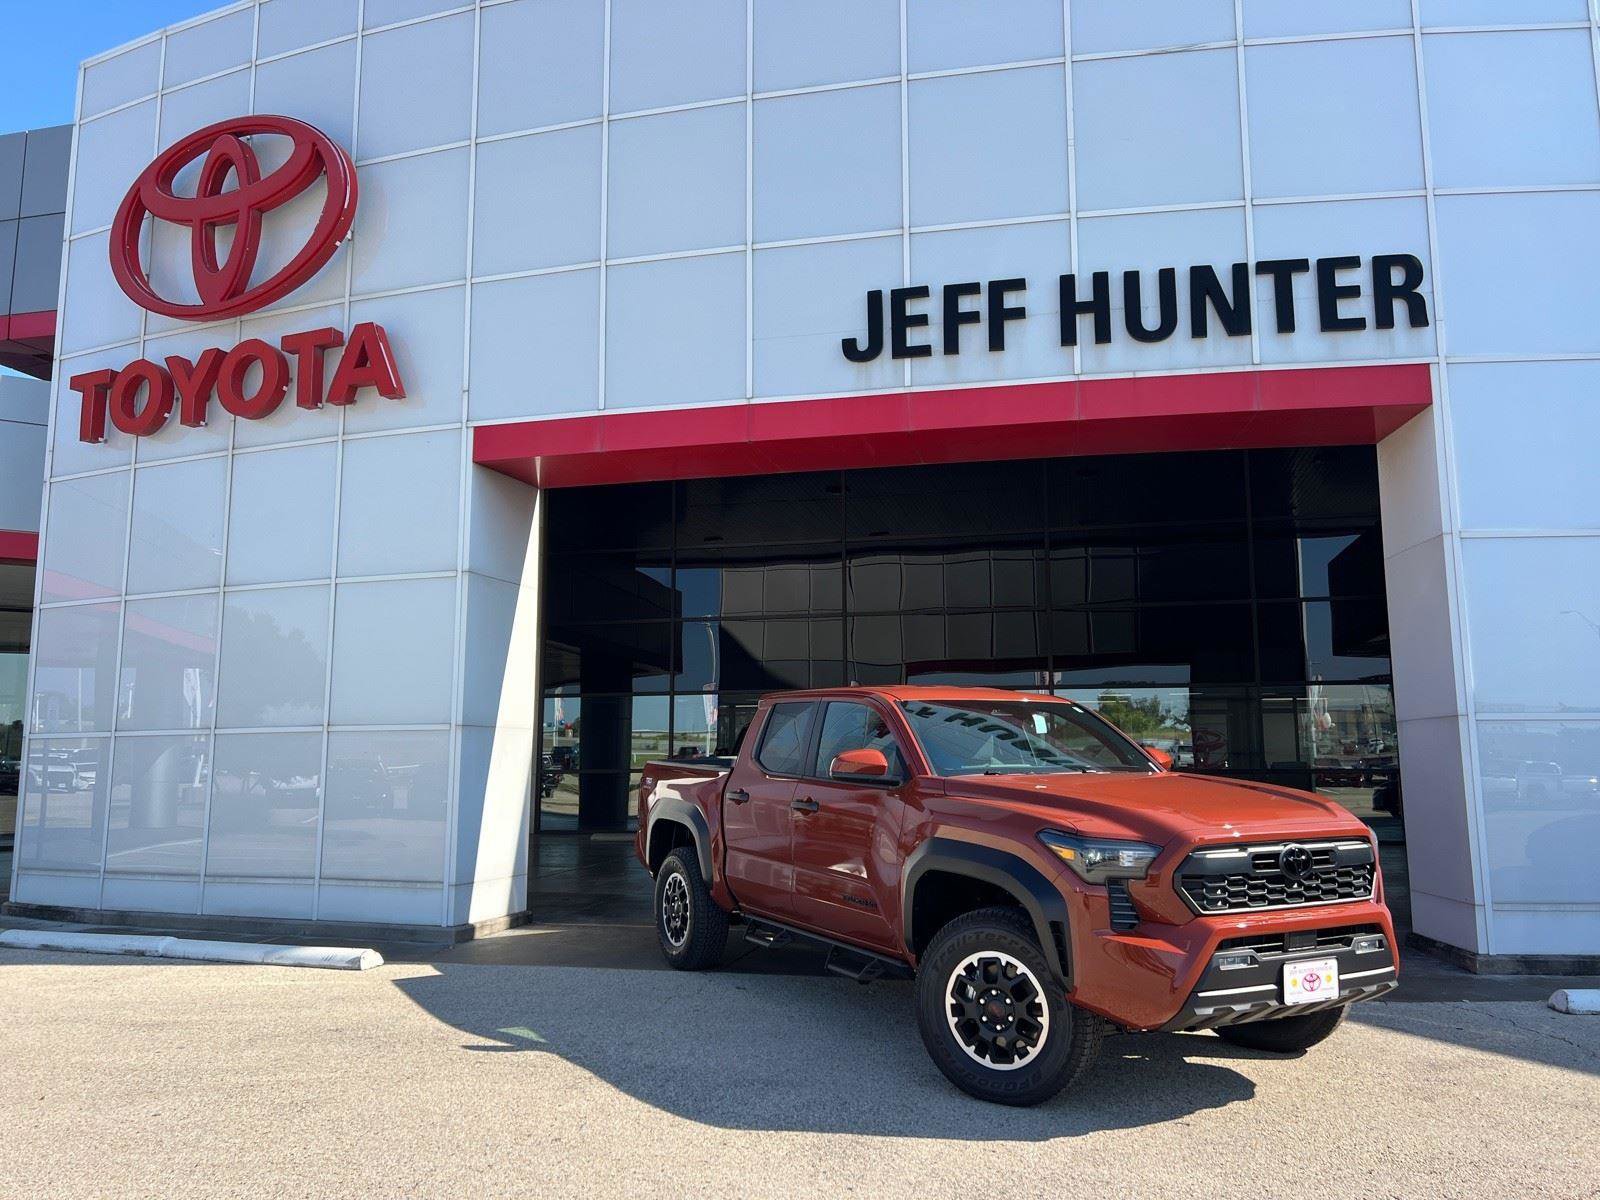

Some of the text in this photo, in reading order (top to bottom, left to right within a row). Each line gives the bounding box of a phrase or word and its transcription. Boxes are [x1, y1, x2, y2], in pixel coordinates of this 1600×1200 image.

[842, 253, 1429, 363] JEFF HUNTER
[70, 321, 407, 444] TOYOTA
